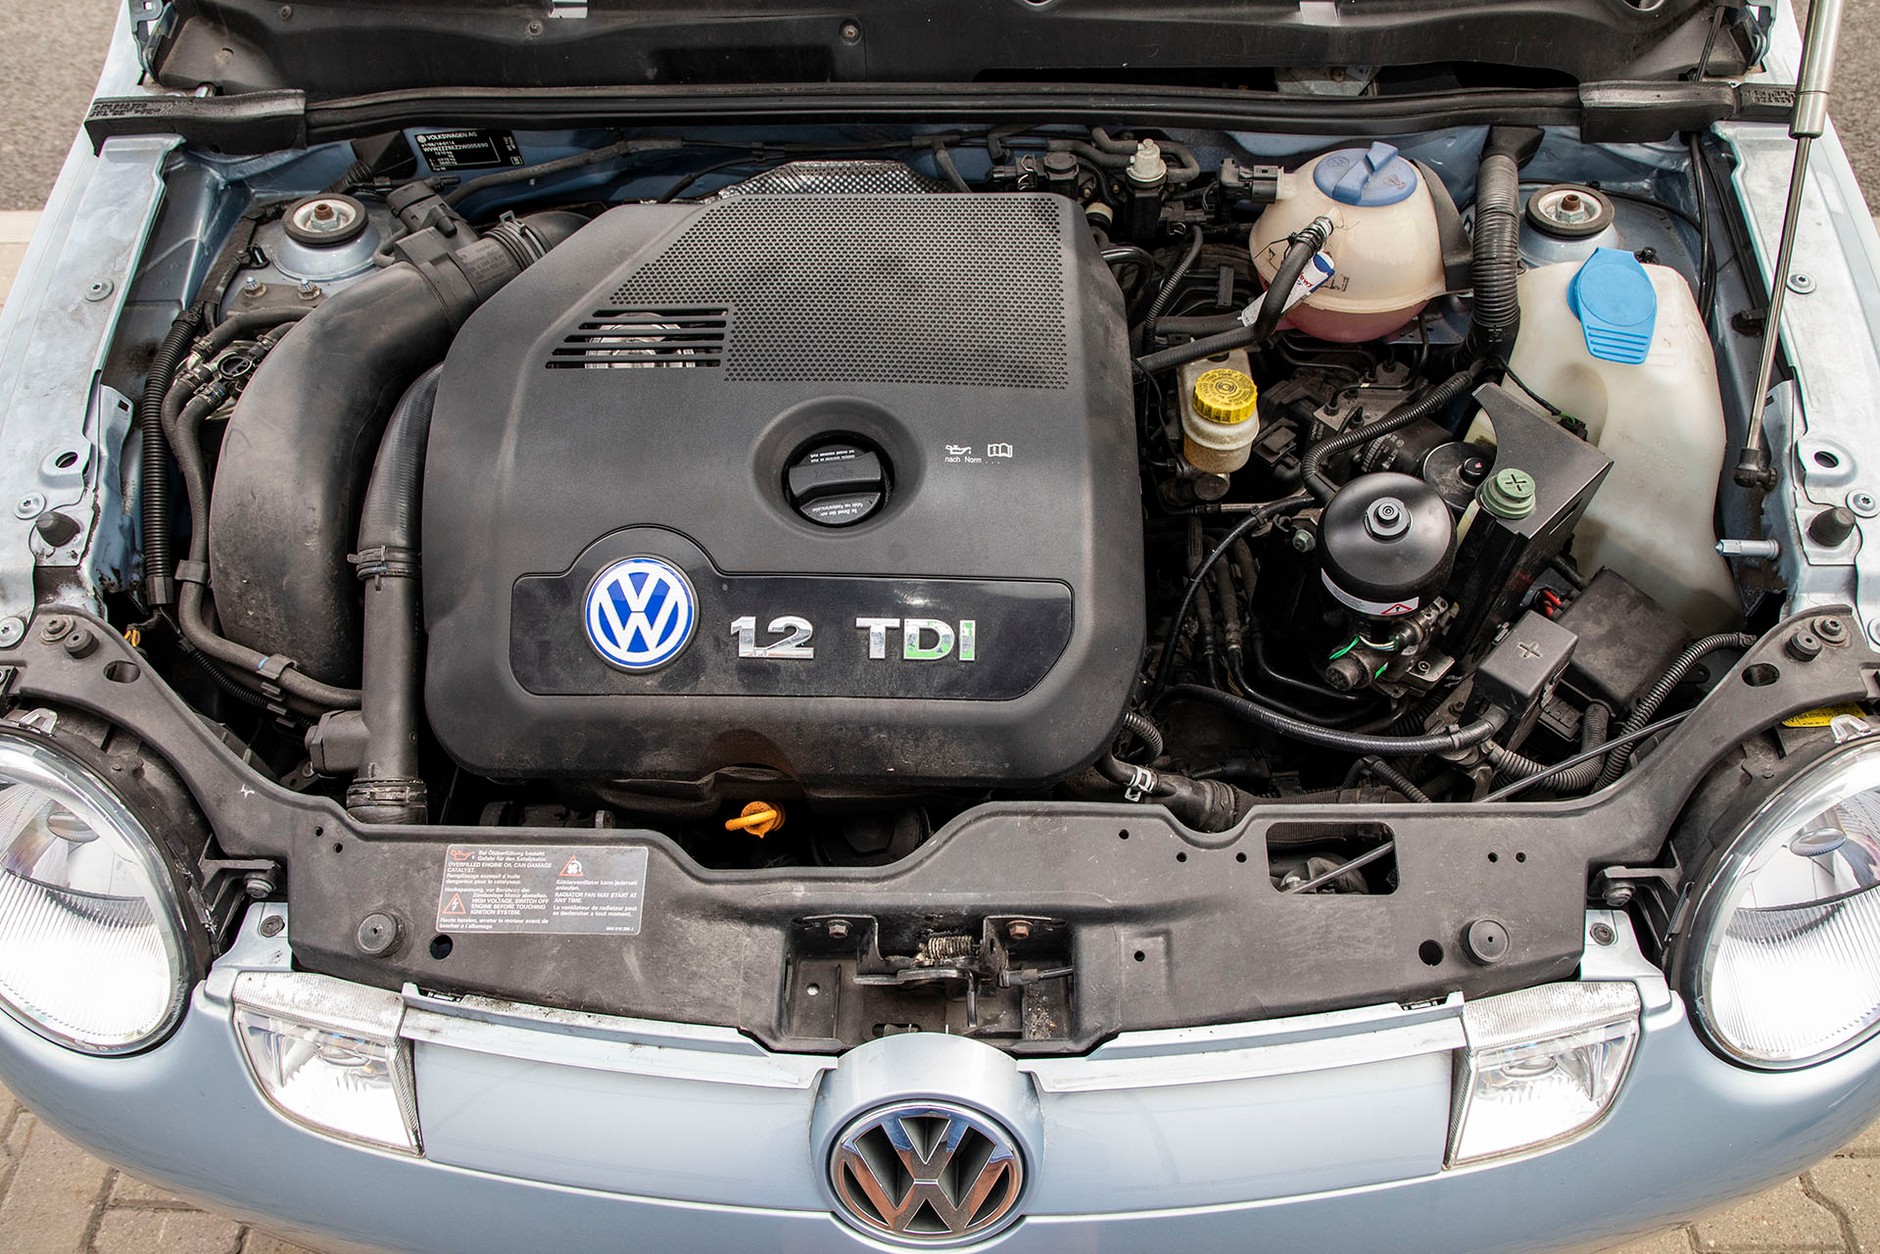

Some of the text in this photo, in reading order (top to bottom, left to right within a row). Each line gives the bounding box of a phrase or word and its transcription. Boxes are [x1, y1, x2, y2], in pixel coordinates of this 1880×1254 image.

[426, 132, 468, 140] VOLKSWAGEN
[588, 560, 692, 665] VW
[856, 618, 975, 661] TDI
[836, 1106, 1019, 1237] VW
